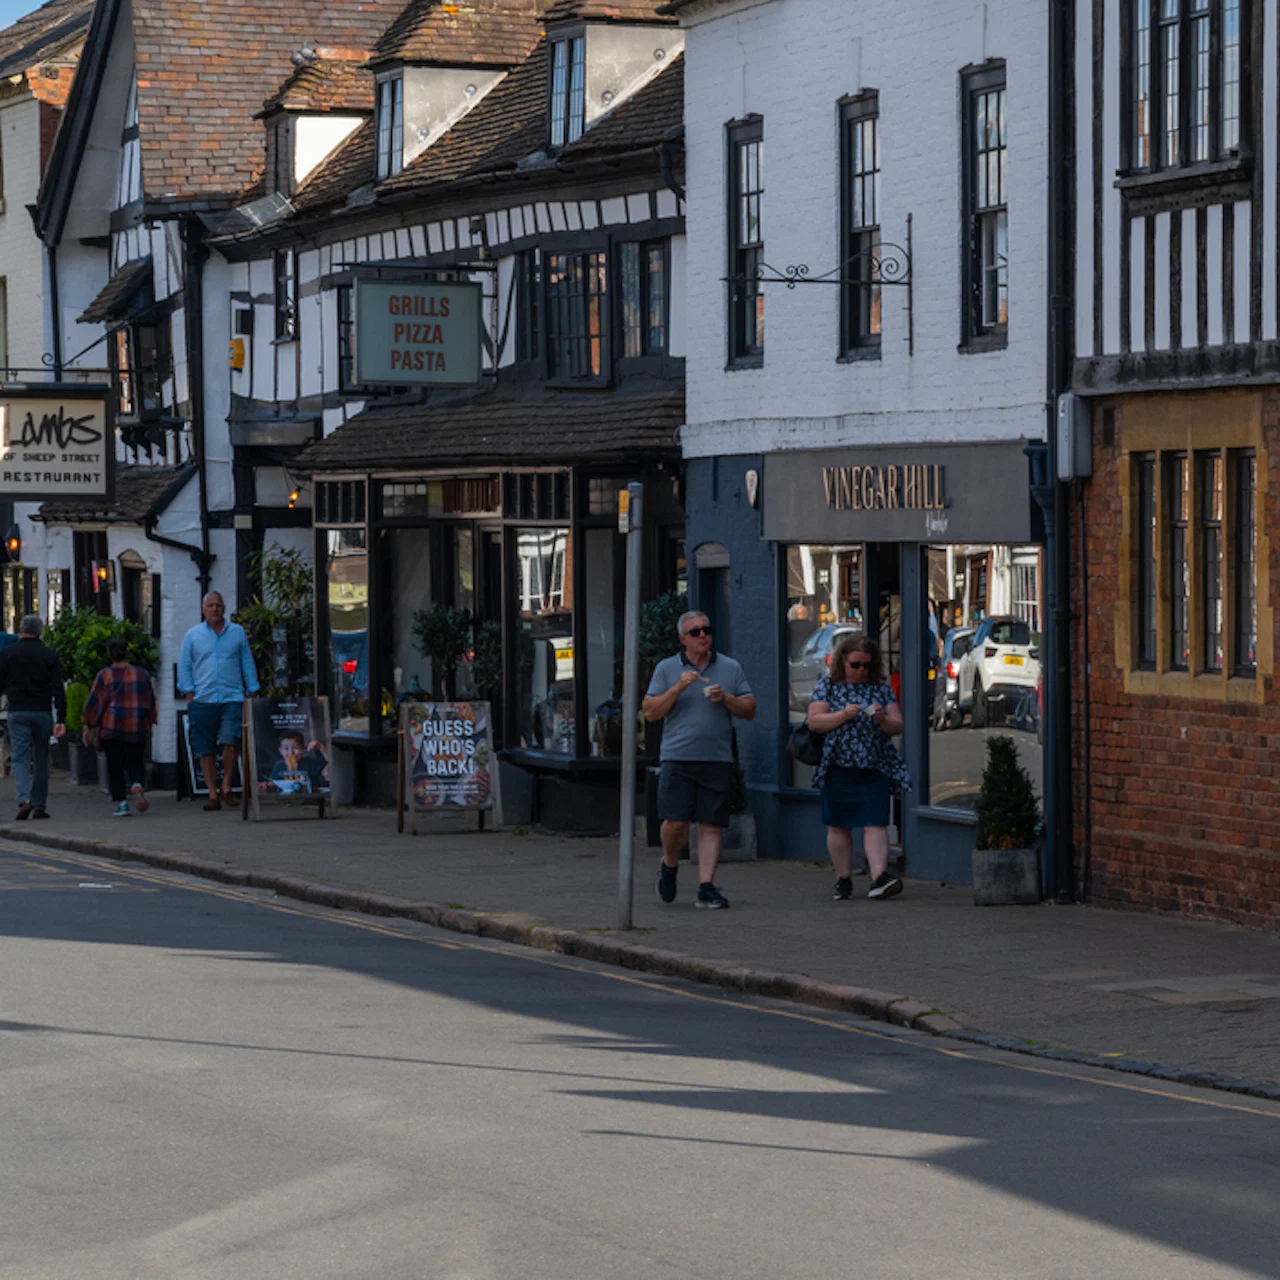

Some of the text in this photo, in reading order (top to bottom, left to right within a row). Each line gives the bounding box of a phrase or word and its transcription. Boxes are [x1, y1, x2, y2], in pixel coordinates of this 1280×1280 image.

[388, 294, 449, 317] GRILLS
[393, 323, 443, 344] PIZZA
[390, 349, 446, 372] PASTA
[3, 452, 100, 463] OF SHEEP STREET
[3, 471, 101, 483] RESTAURANT
[822, 463, 945, 510] VINEGAR HILL
[422, 719, 474, 737] GUESS
[422, 738, 475, 756] WHO'S
[426, 757, 475, 776] BACK!
